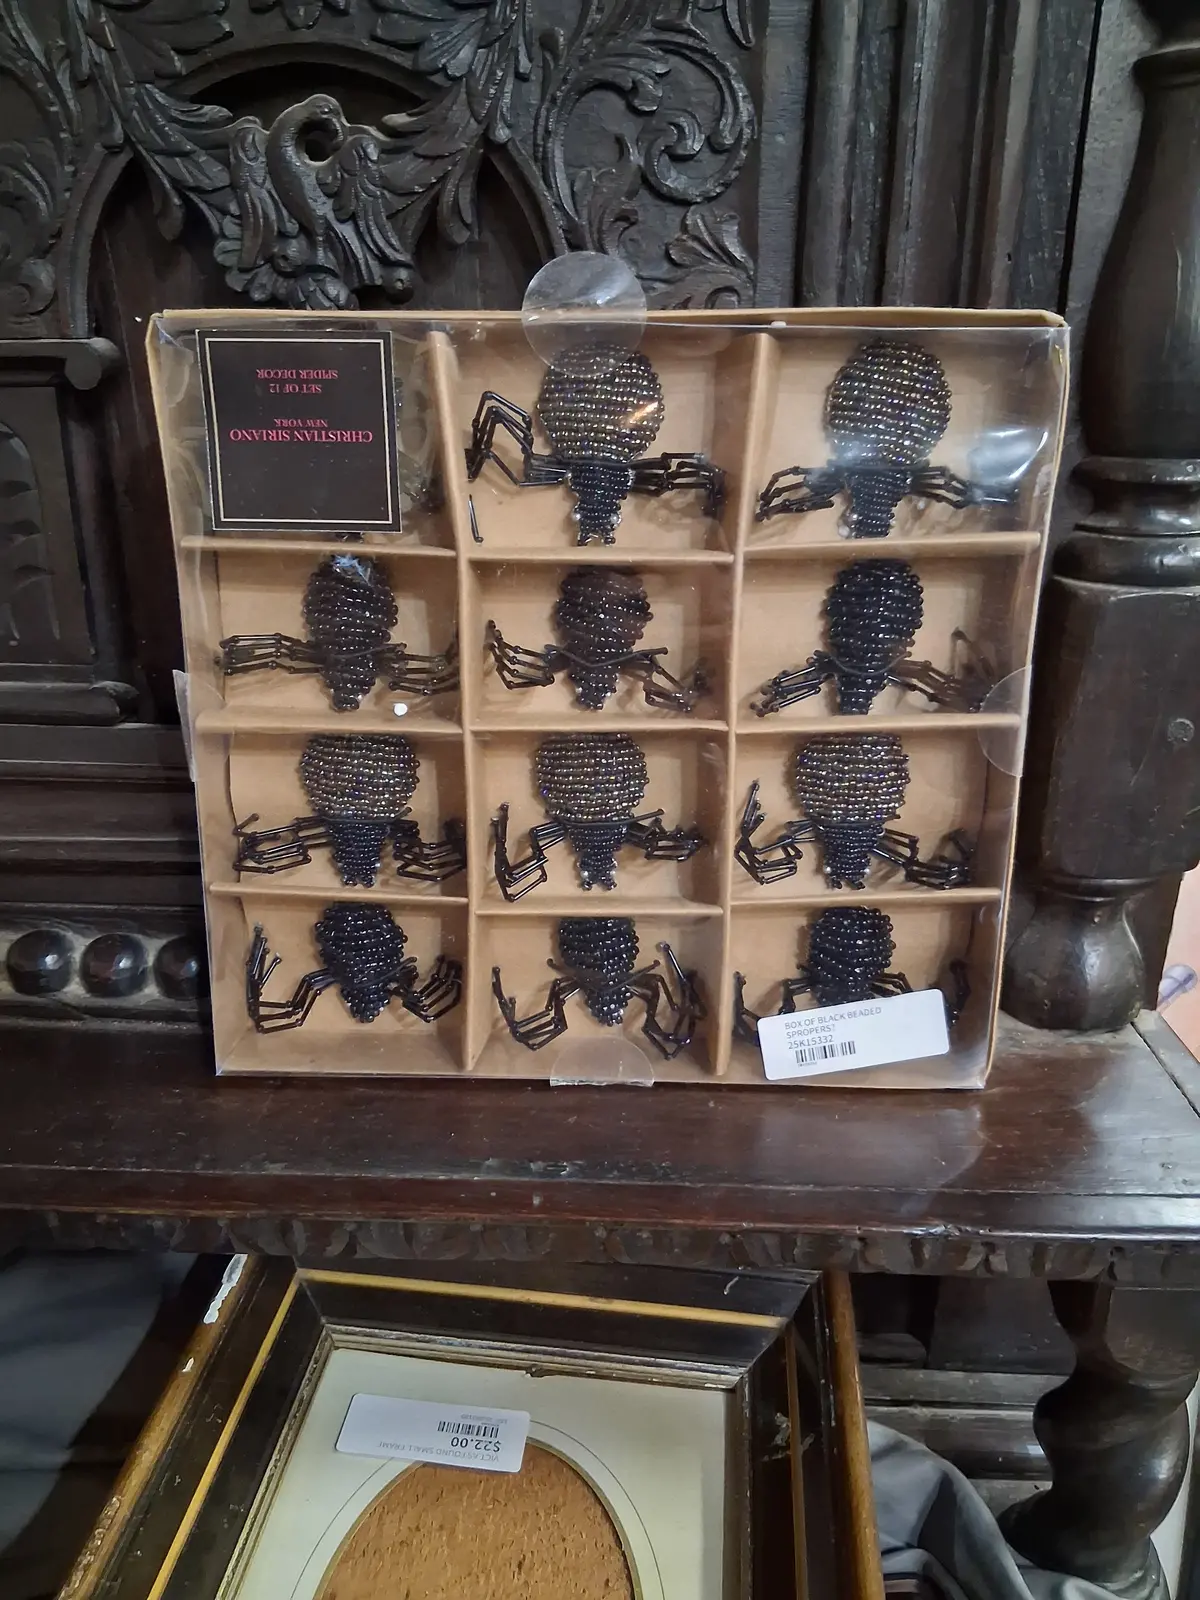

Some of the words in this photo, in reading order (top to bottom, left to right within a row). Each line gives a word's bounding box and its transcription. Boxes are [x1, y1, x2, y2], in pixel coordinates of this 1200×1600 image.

[256, 369, 296, 379] DECOR
[300, 369, 339, 380] SPIDER
[269, 383, 280, 394] 12
[283, 383, 299, 394] OF
[302, 384, 322, 394] SET
[274, 418, 302, 427] YORK
[305, 419, 328, 428] NEW
[229, 429, 290, 442] SIRIANO
[294, 430, 373, 443] CHRISTIAN
[785, 1020, 803, 1030] BOX
[804, 1018, 816, 1027] OF
[817, 1013, 846, 1024] BLACK
[847, 1007, 882, 1019] BEADED
[788, 1034, 834, 1050] 25K15332
[409, 1444, 435, 1455] SMALL
[450, 1437, 502, 1453] $22.00
